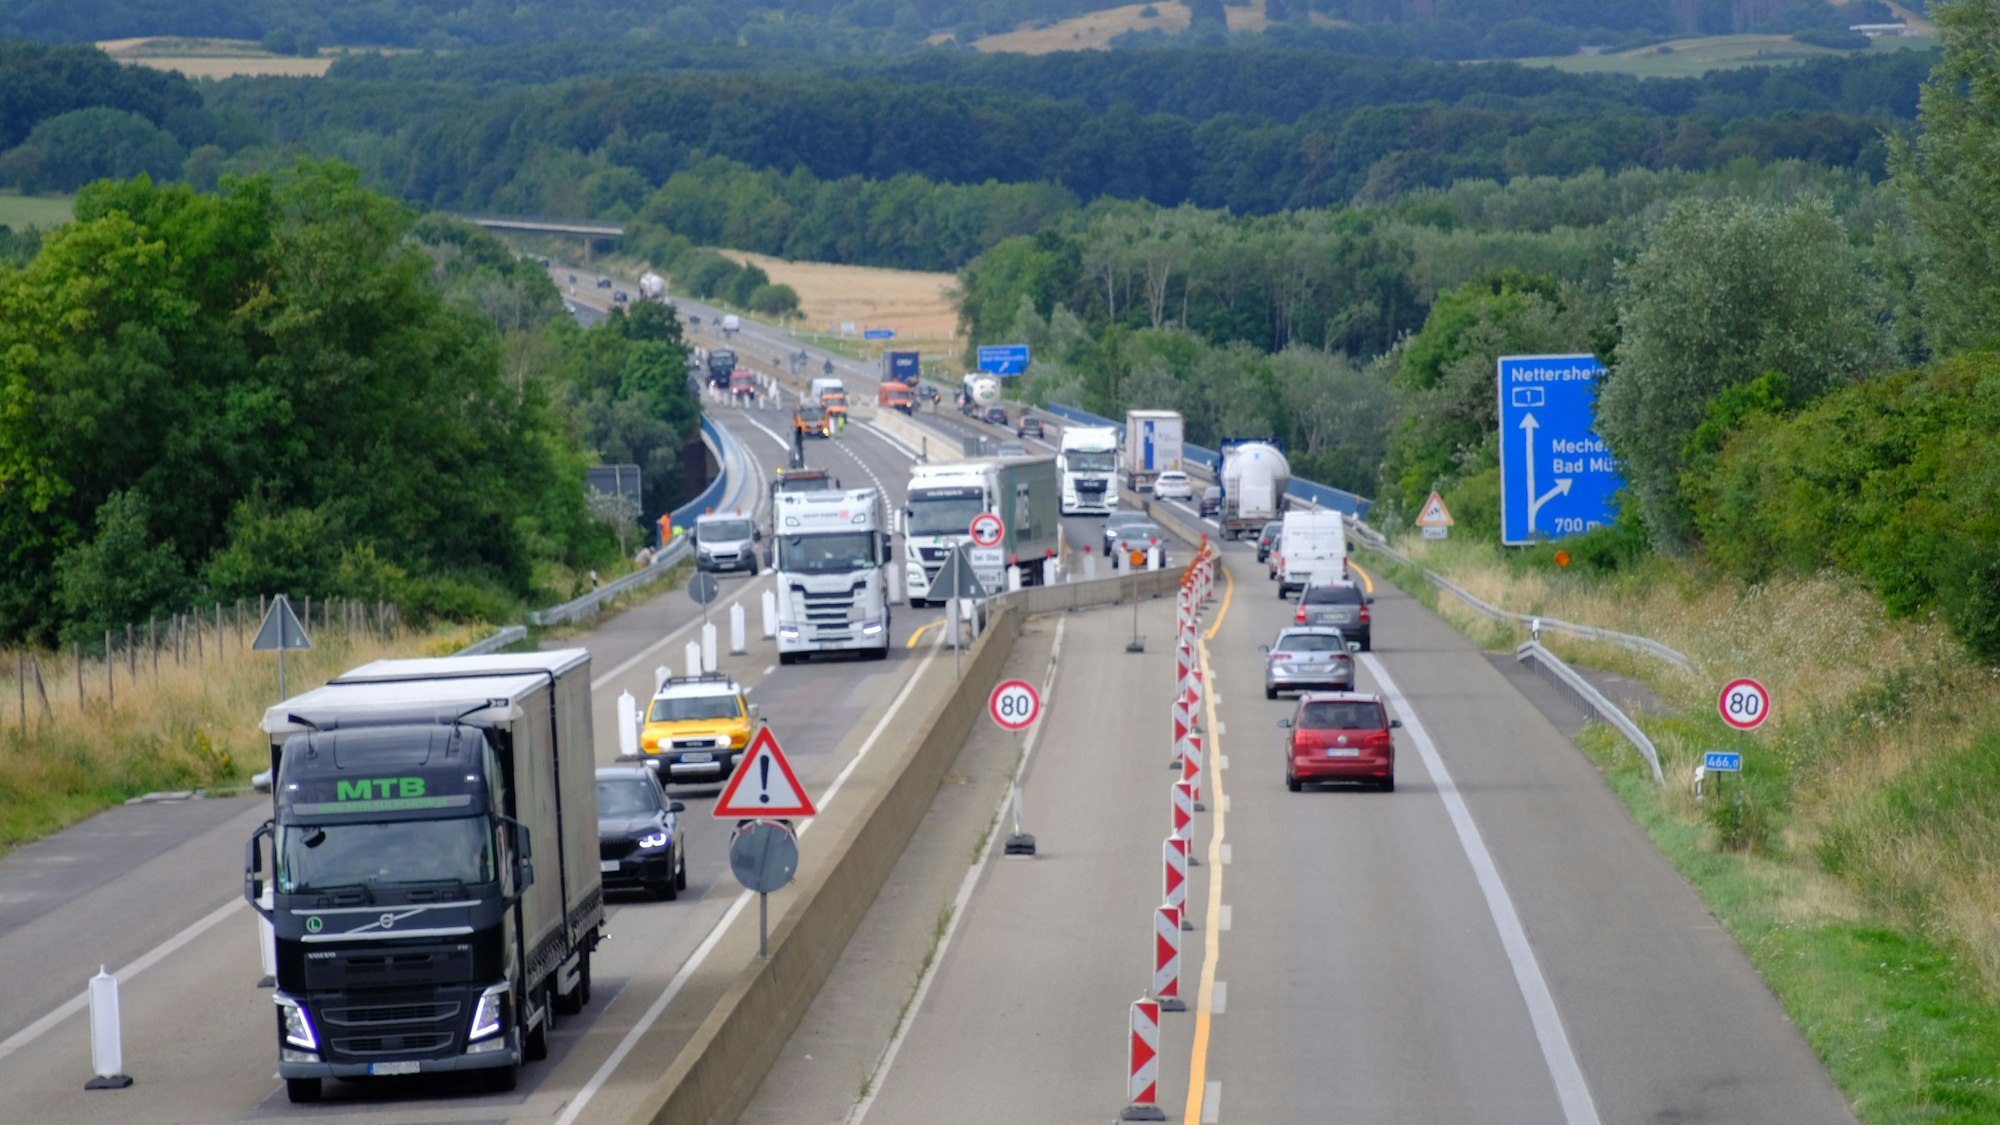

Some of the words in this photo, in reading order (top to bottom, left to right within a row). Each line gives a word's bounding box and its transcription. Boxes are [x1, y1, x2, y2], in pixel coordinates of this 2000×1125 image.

[1525, 390, 1532, 403] 1
[1553, 458, 1583, 473] Bad
[1555, 517, 1583, 533] 700
[1001, 695, 1029, 716] 80
[1730, 692, 1758, 715] 80
[337, 777, 425, 800] MTB
